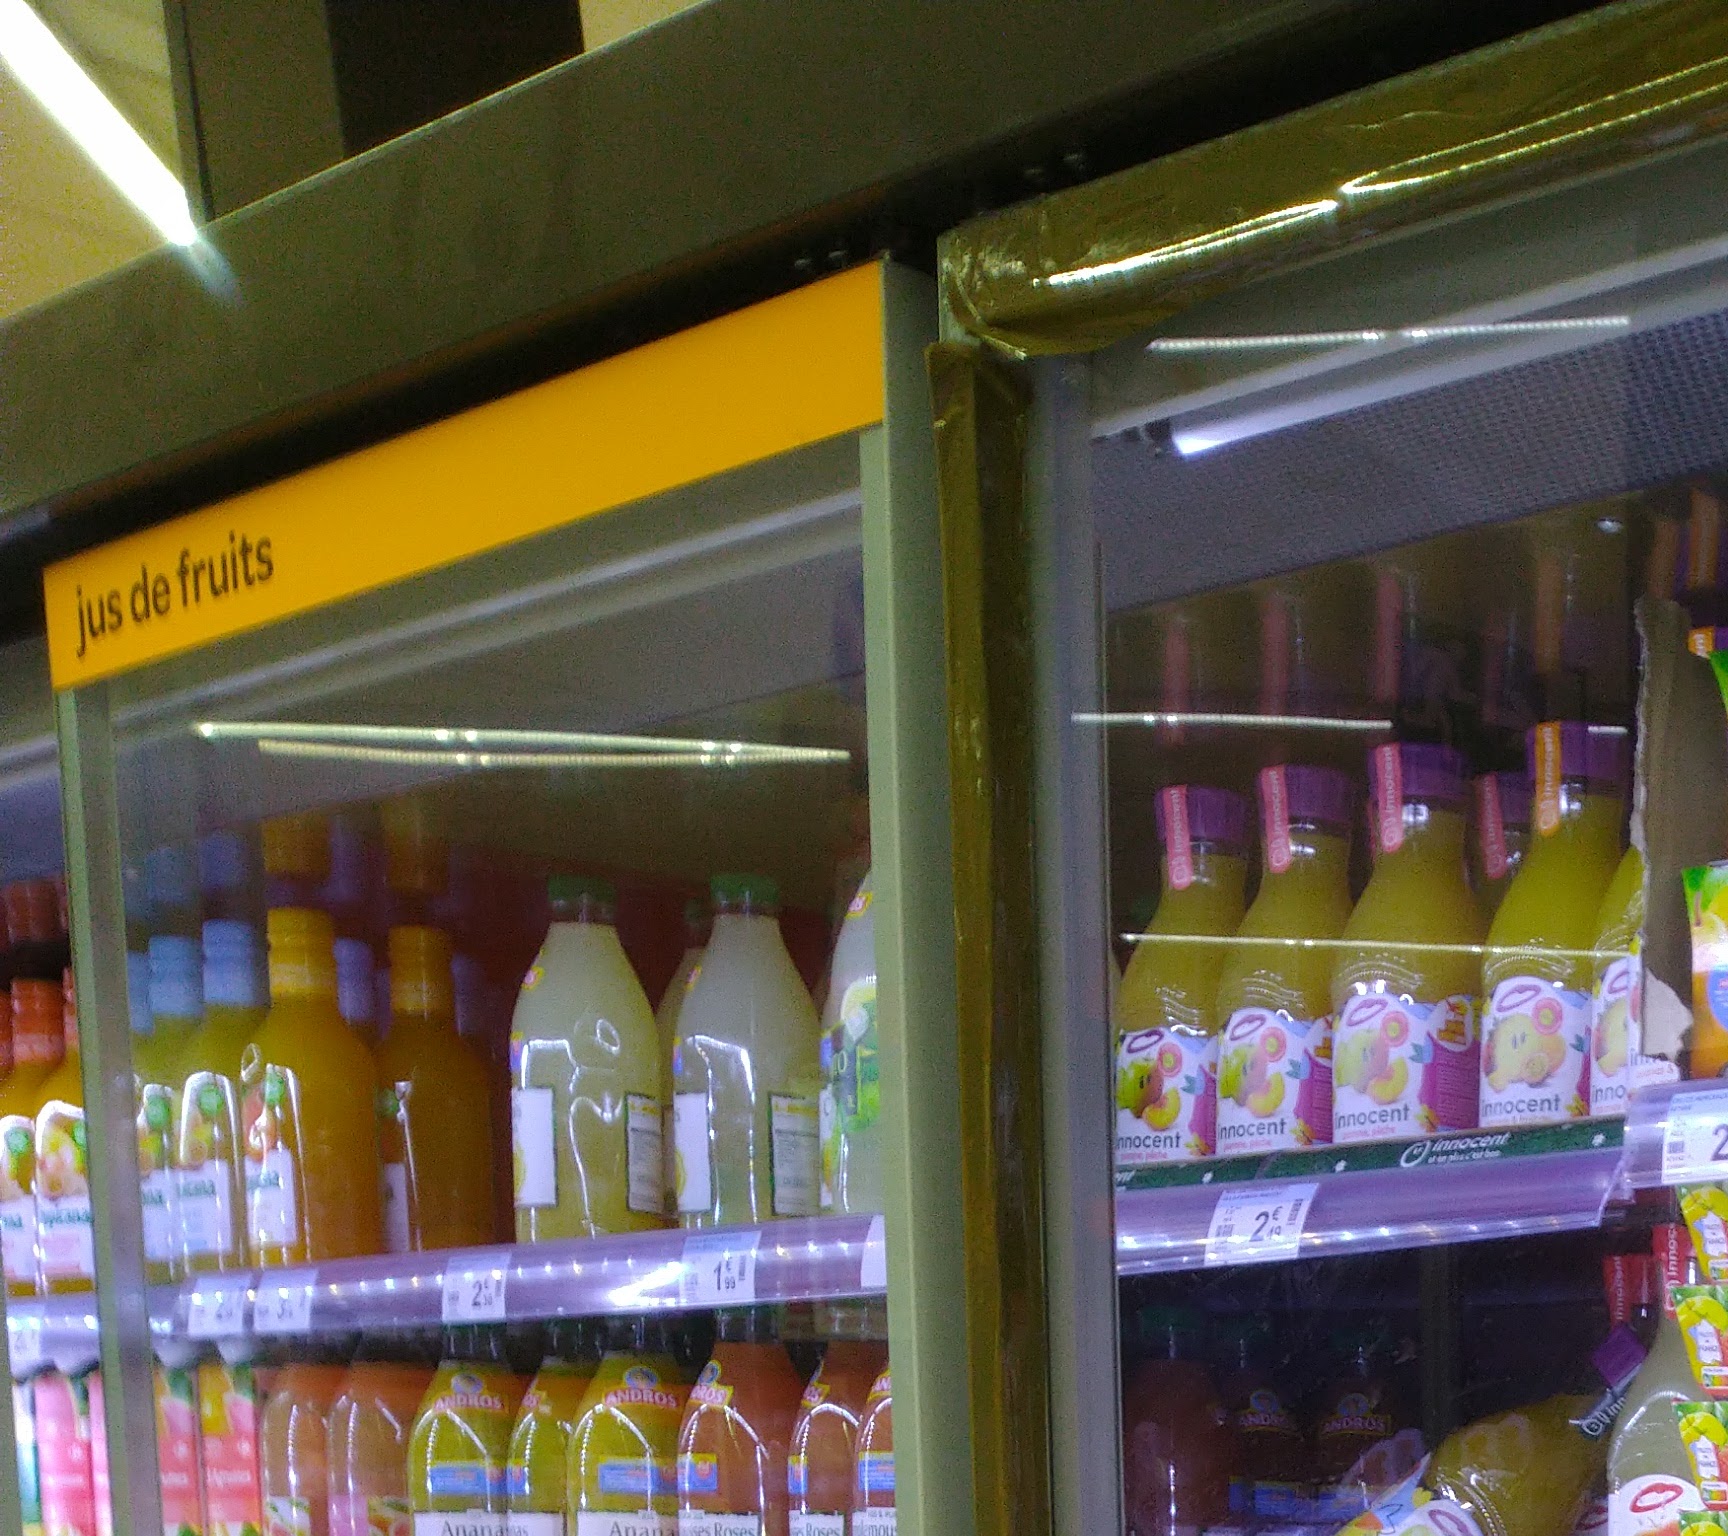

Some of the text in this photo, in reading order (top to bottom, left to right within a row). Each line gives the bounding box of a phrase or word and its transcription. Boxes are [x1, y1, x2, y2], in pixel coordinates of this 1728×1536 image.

[76, 531, 274, 657] jus de fruits
